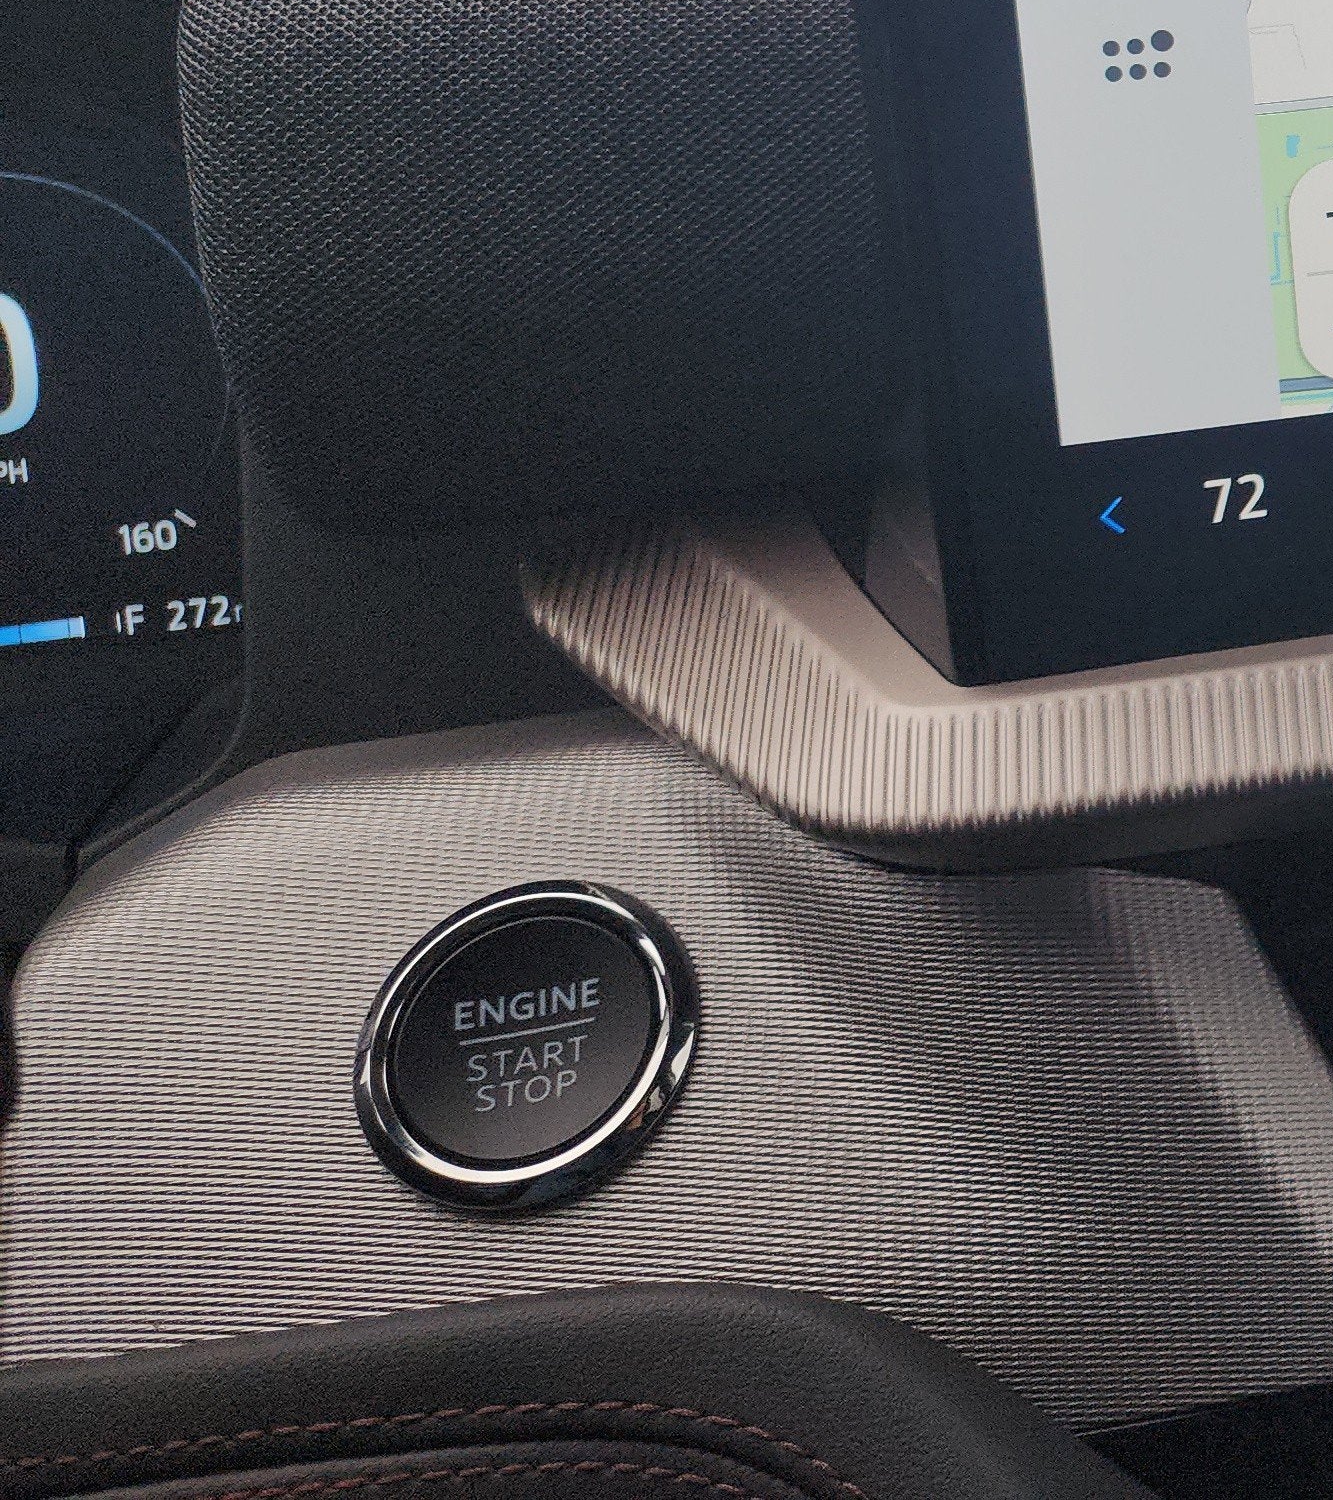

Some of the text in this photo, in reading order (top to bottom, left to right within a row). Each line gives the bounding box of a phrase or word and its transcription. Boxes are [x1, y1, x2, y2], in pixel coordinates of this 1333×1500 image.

[1203, 473, 1268, 524] 72
[117, 519, 178, 556] 160
[454, 977, 601, 1031] ENGINE
[466, 1035, 588, 1082] START
[475, 1069, 578, 1112] STOP
